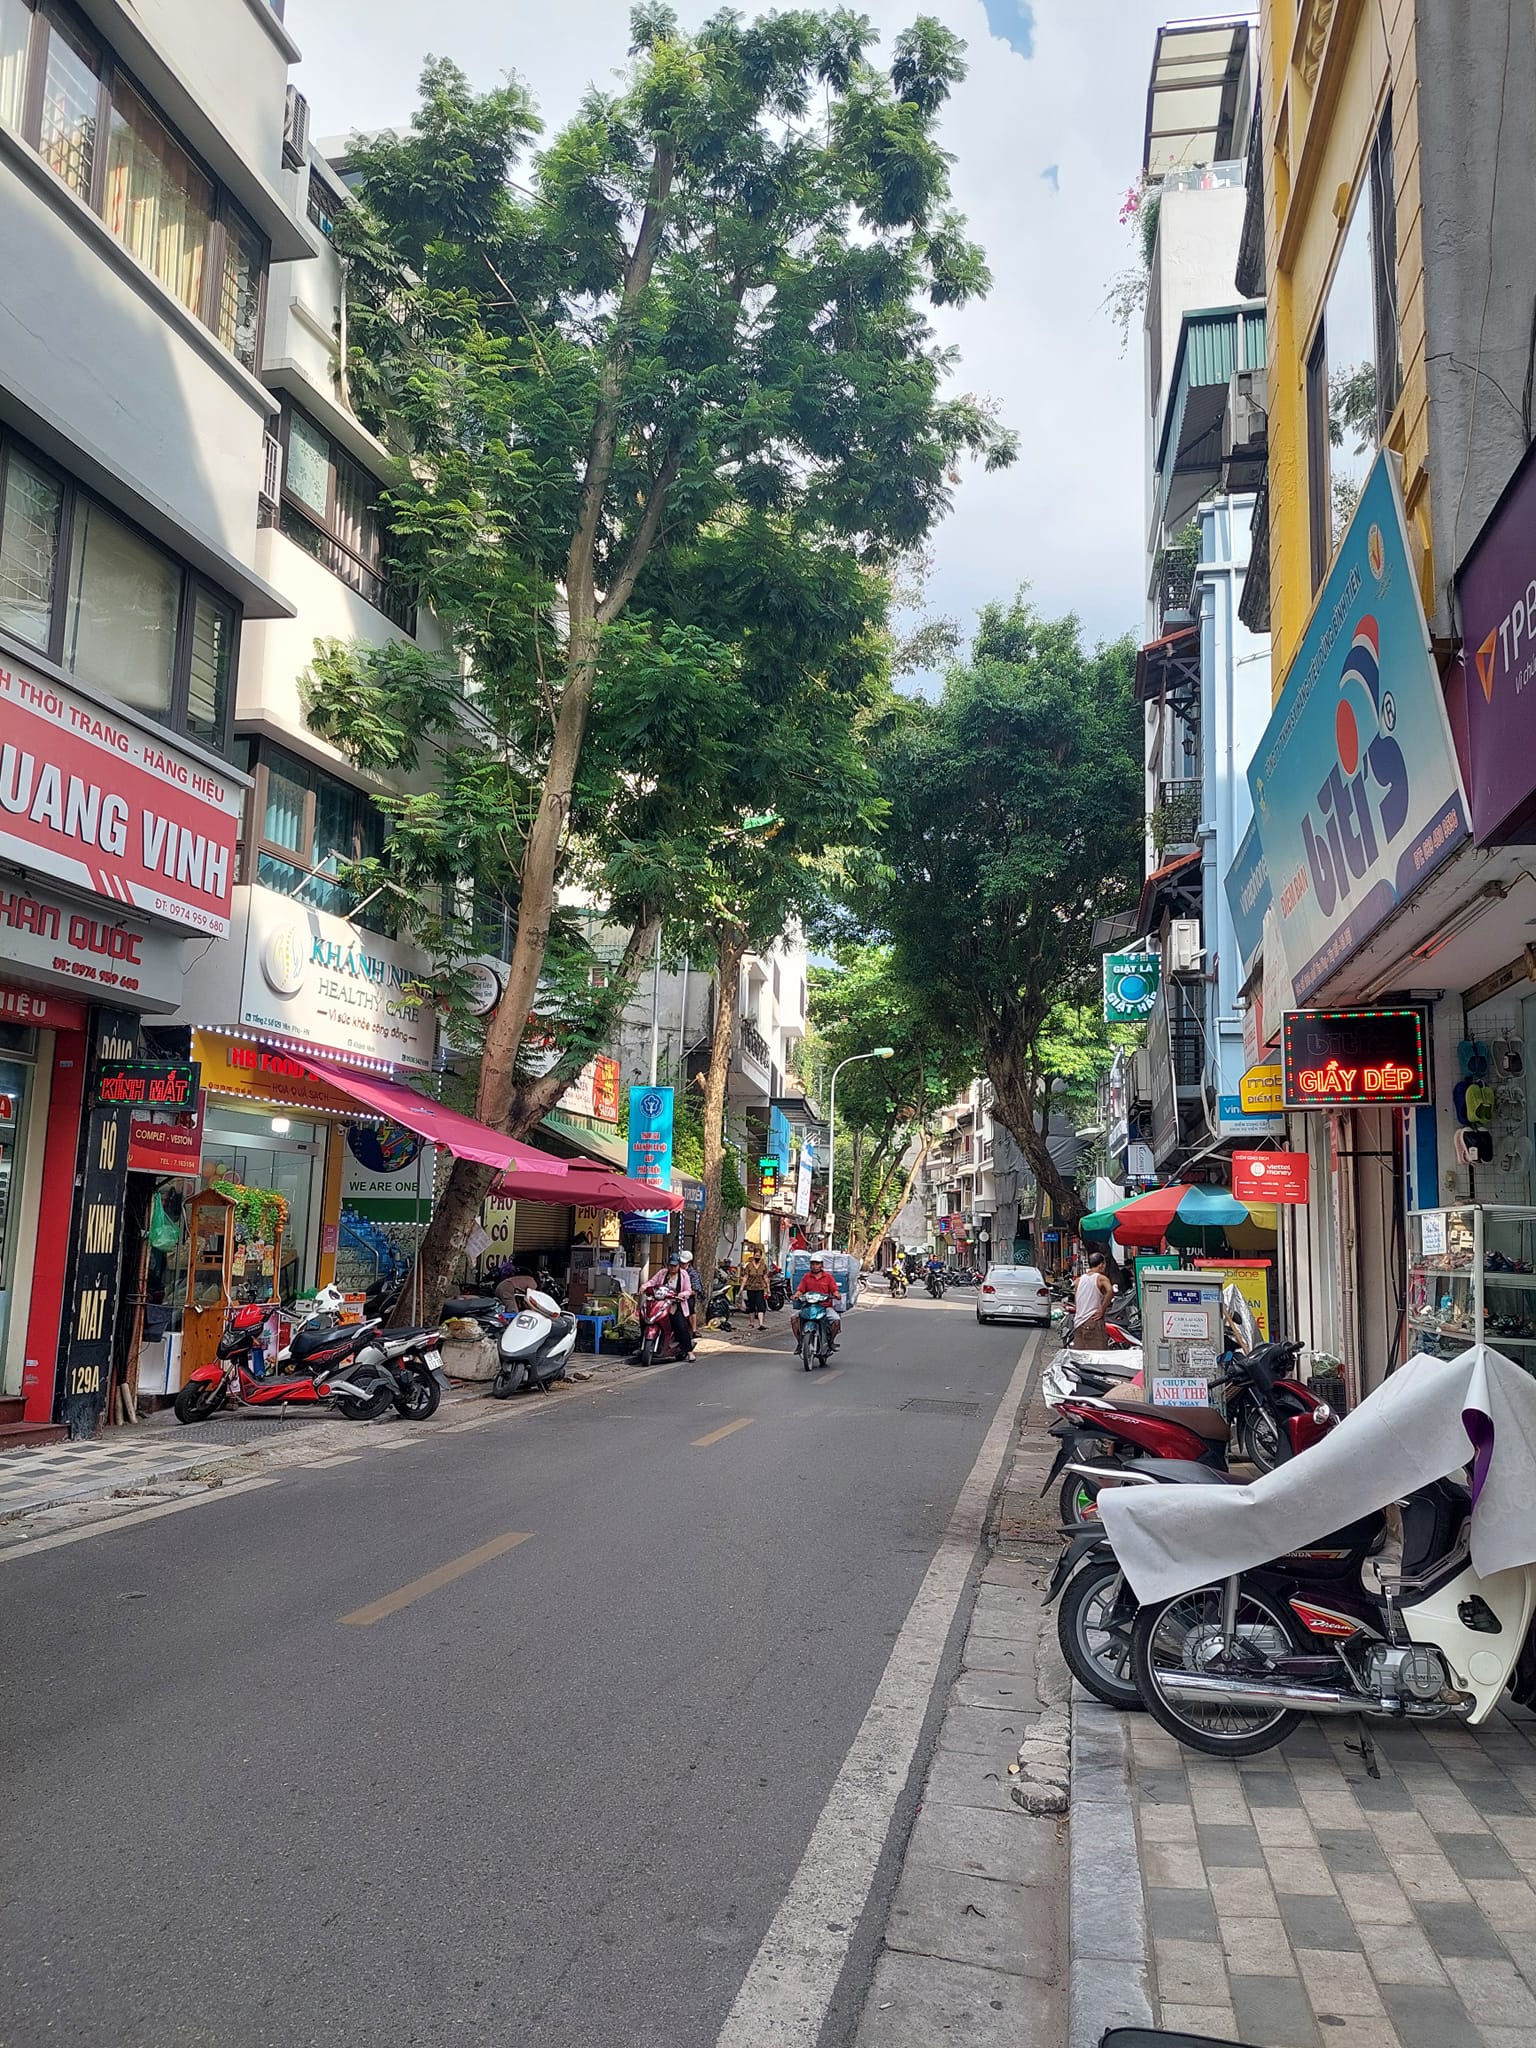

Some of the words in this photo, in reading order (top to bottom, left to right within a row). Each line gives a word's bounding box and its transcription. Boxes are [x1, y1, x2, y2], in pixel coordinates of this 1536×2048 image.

[1331, 591, 1348, 638] BÌNH
[1344, 559, 1361, 608] TIÊN
[18, 678, 63, 718] THỜI
[69, 706, 129, 753] TRANG
[143, 746, 188, 784] HÀNG
[192, 772, 225, 803] HIỆU
[142, 809, 230, 899] VINH
[155, 898, 168, 912] ĐT:
[169, 902, 191, 920] 0974
[192, 912, 208, 926] 959
[209, 918, 224, 933] 680
[68, 914, 144, 965] QUỐC
[310, 936, 385, 984] KHÁNH
[1113, 964, 1137, 975] GIẶT
[1140, 962, 1153, 973] LÀ
[318, 977, 383, 1012] HEALTHY
[386, 1000, 420, 1023] CARE
[1107, 993, 1134, 1014] GIẶT
[338, 1012, 351, 1025] sức
[352, 1015, 370, 1030] khỏe
[371, 1021, 389, 1038] cộng
[390, 1027, 408, 1043] đồng
[231, 1047, 257, 1069] HB
[261, 1053, 304, 1079] FOOD
[1364, 1062, 1413, 1092] DÉP
[101, 1071, 145, 1100] KÍNH
[272, 1082, 289, 1094] HOA
[135, 1129, 166, 1142] COMPLET
[171, 1134, 193, 1147] VESTON
[349, 1181, 366, 1192] WE
[369, 1181, 392, 1192] ARE
[395, 1181, 419, 1192] ONE
[85, 1193, 116, 1254] KÍNH
[77, 1272, 107, 1341] MẮT
[71, 1365, 101, 1394] 129A
[1155, 1382, 1179, 1400] ẢNH
[1309, 1618, 1354, 1630] Dream
